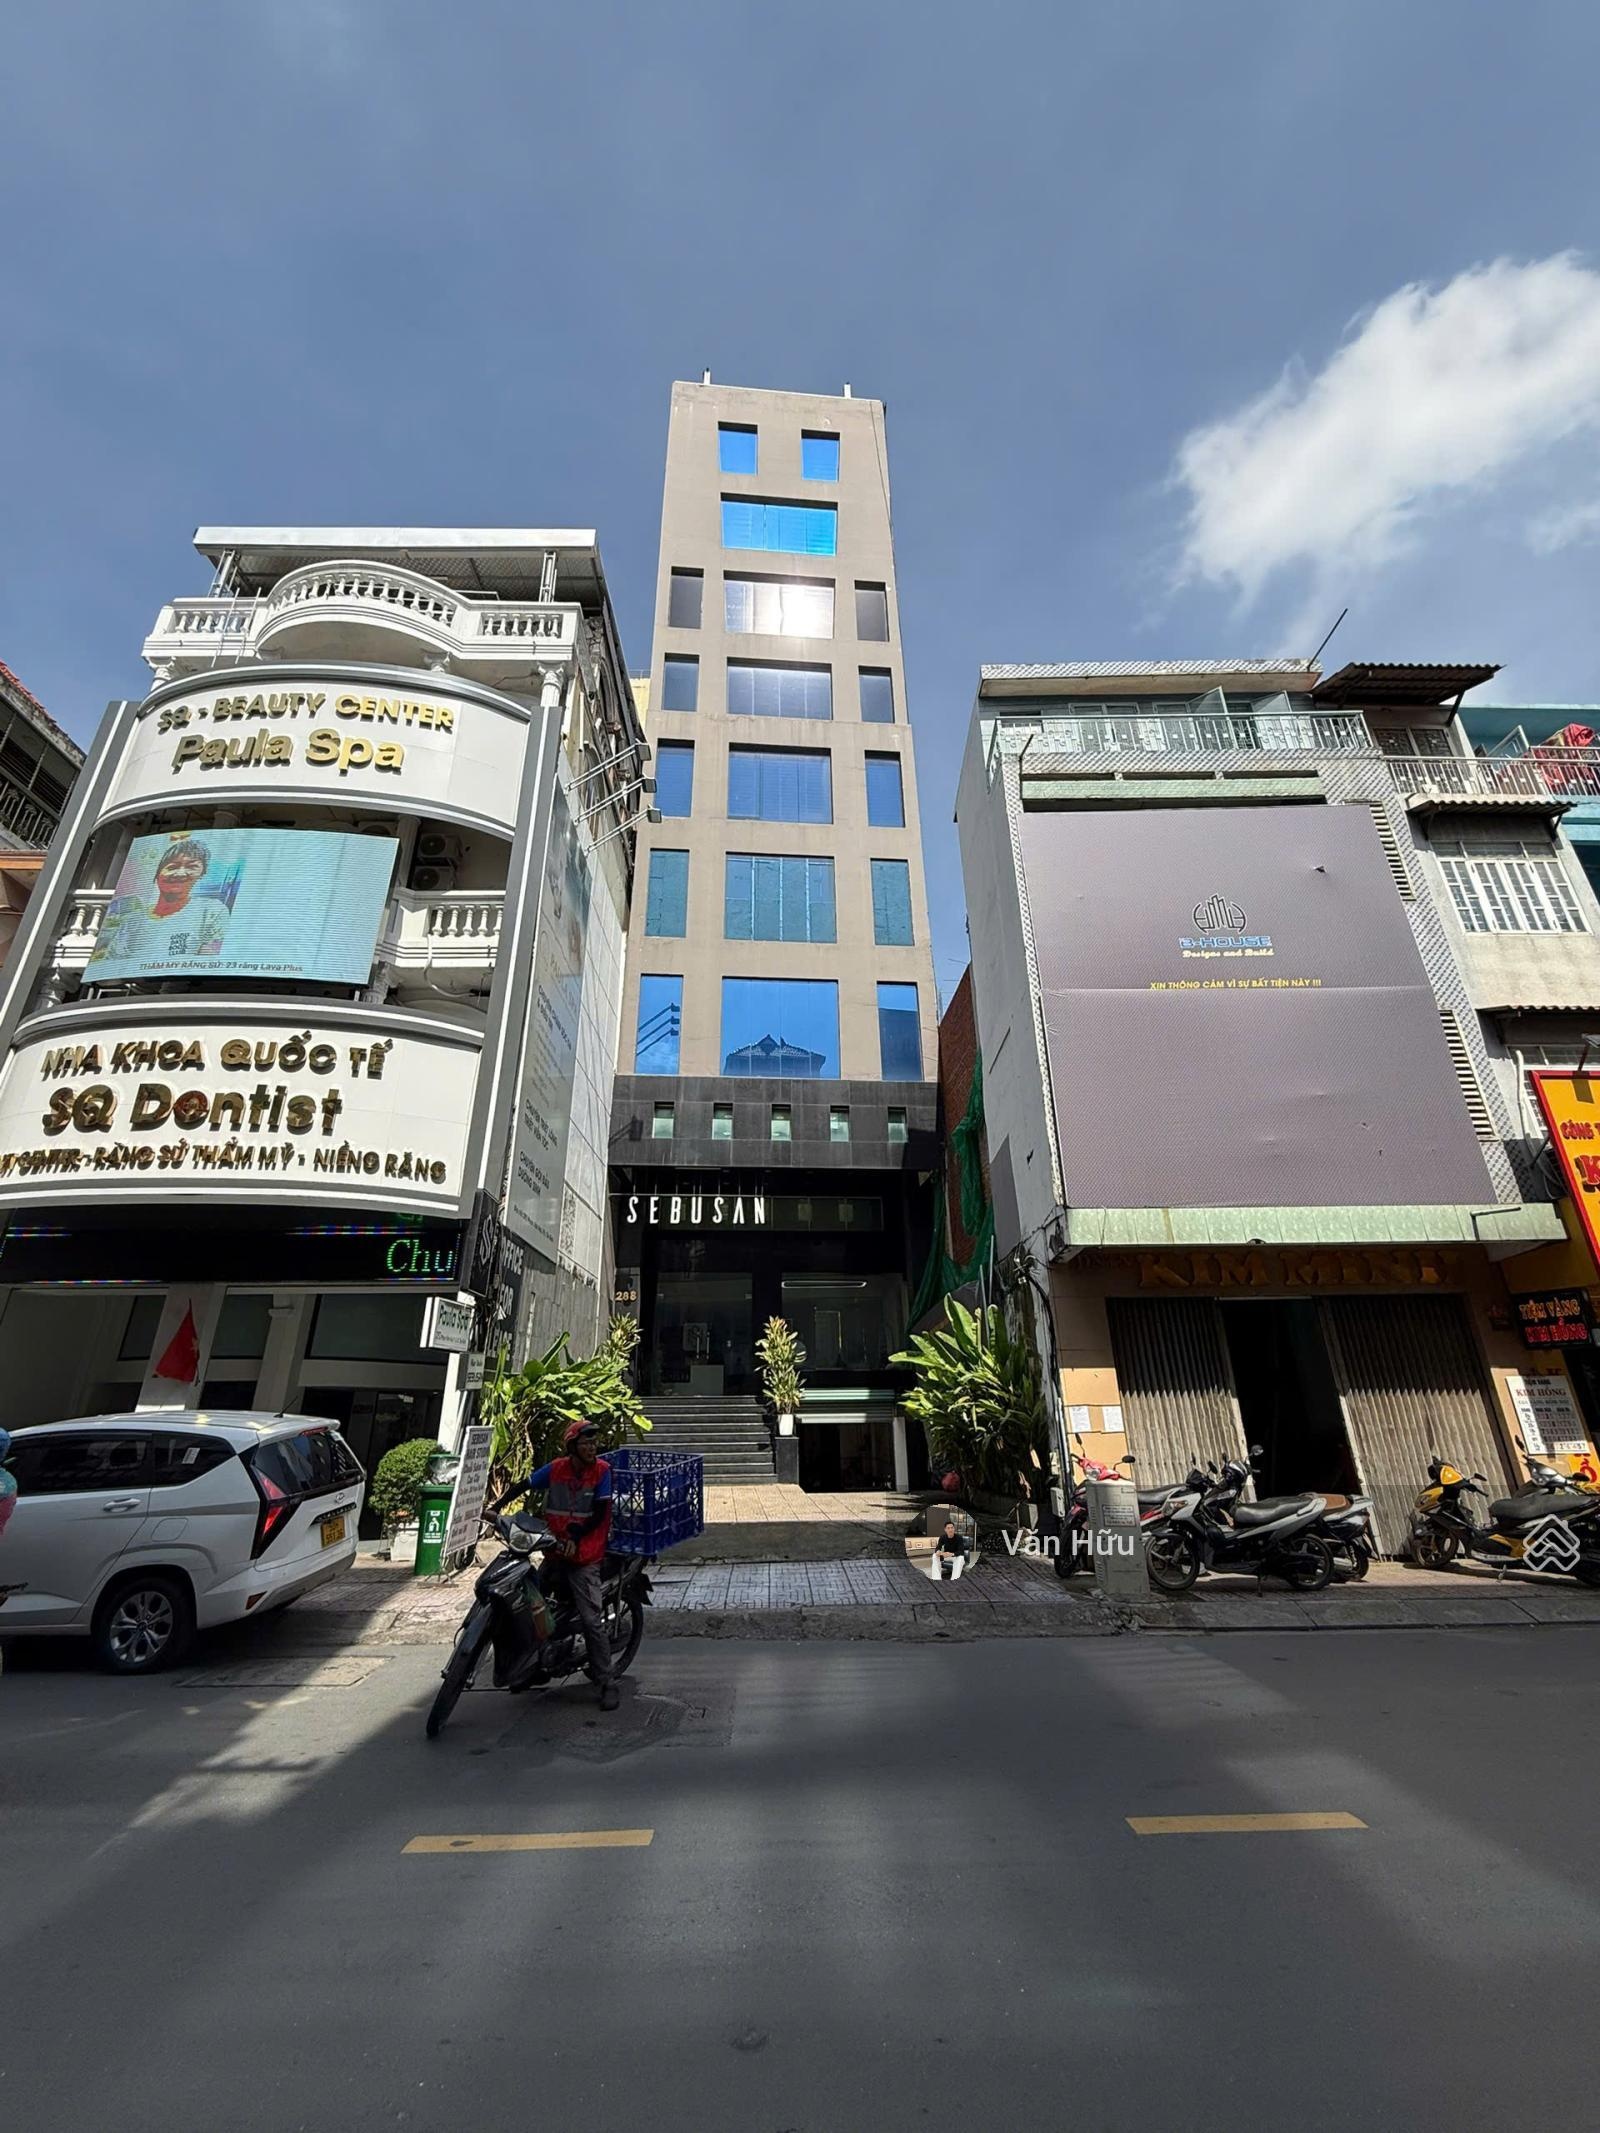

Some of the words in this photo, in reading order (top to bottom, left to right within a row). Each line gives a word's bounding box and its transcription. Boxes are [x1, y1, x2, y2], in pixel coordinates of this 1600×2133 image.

[157, 706, 192, 734] SQ
[211, 693, 325, 723] BEAUTY
[335, 694, 455, 734] CENTER
[171, 728, 294, 775] Paula
[305, 728, 405, 776] Spa
[1179, 936, 1272, 949] B-HOUSE
[1223, 949, 1243, 958] and
[1245, 948, 1275, 957] Build
[1150, 981, 1166, 990] XIN
[1168, 979, 1200, 990] THÔNG
[1202, 978, 1225, 989] CẢM
[1226, 978, 1236, 988] VÌ
[1238, 979, 1249, 990] SỰ
[1251, 977, 1269, 988] BẤT
[1271, 978, 1289, 989] TIỆN
[1291, 977, 1310, 987] NÀY
[41, 1043, 102, 1081] NHA
[110, 1040, 205, 1074] KHOA
[220, 1030, 337, 1075] QUỐC
[349, 1038, 394, 1080] TẾ
[42, 1085, 118, 1136] SQ
[130, 1083, 343, 1136] Dentist
[192, 1136, 255, 1170] THẨM
[384, 1152, 447, 1184] RĂNG
[626, 1196, 766, 1224] SEBUSAN
[386, 1239, 453, 1272] Chu
[1137, 1252, 1271, 1288] KIM
[615, 1290, 638, 1301] 288
[1518, 1300, 1547, 1322] TIỆM
[1546, 1297, 1580, 1317] VÀNG
[1515, 1388, 1536, 1397] KIM
